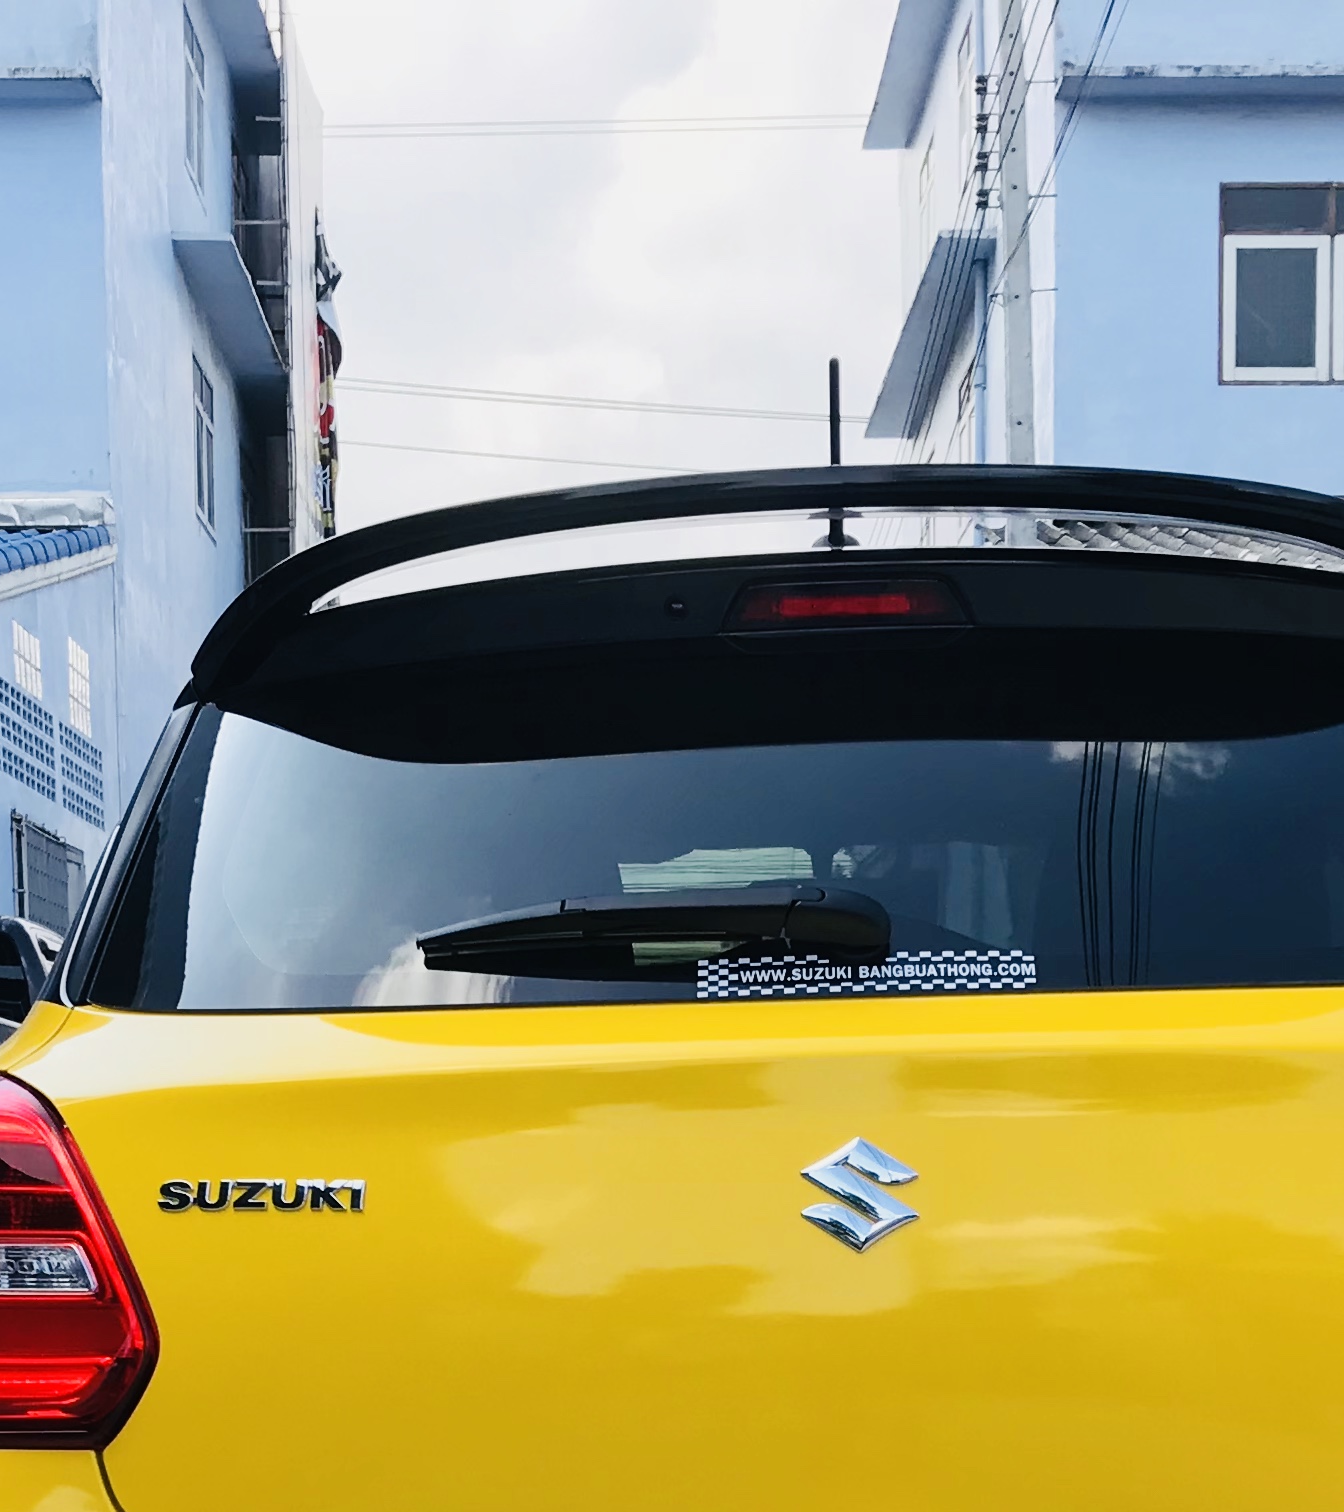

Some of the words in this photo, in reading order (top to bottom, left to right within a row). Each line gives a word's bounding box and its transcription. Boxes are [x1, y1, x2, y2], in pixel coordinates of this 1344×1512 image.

[740, 966, 852, 983] WWW.SUZUKI
[858, 962, 1037, 979] BANGBUATHONG.COM
[157, 1178, 367, 1213] SUZUKI
